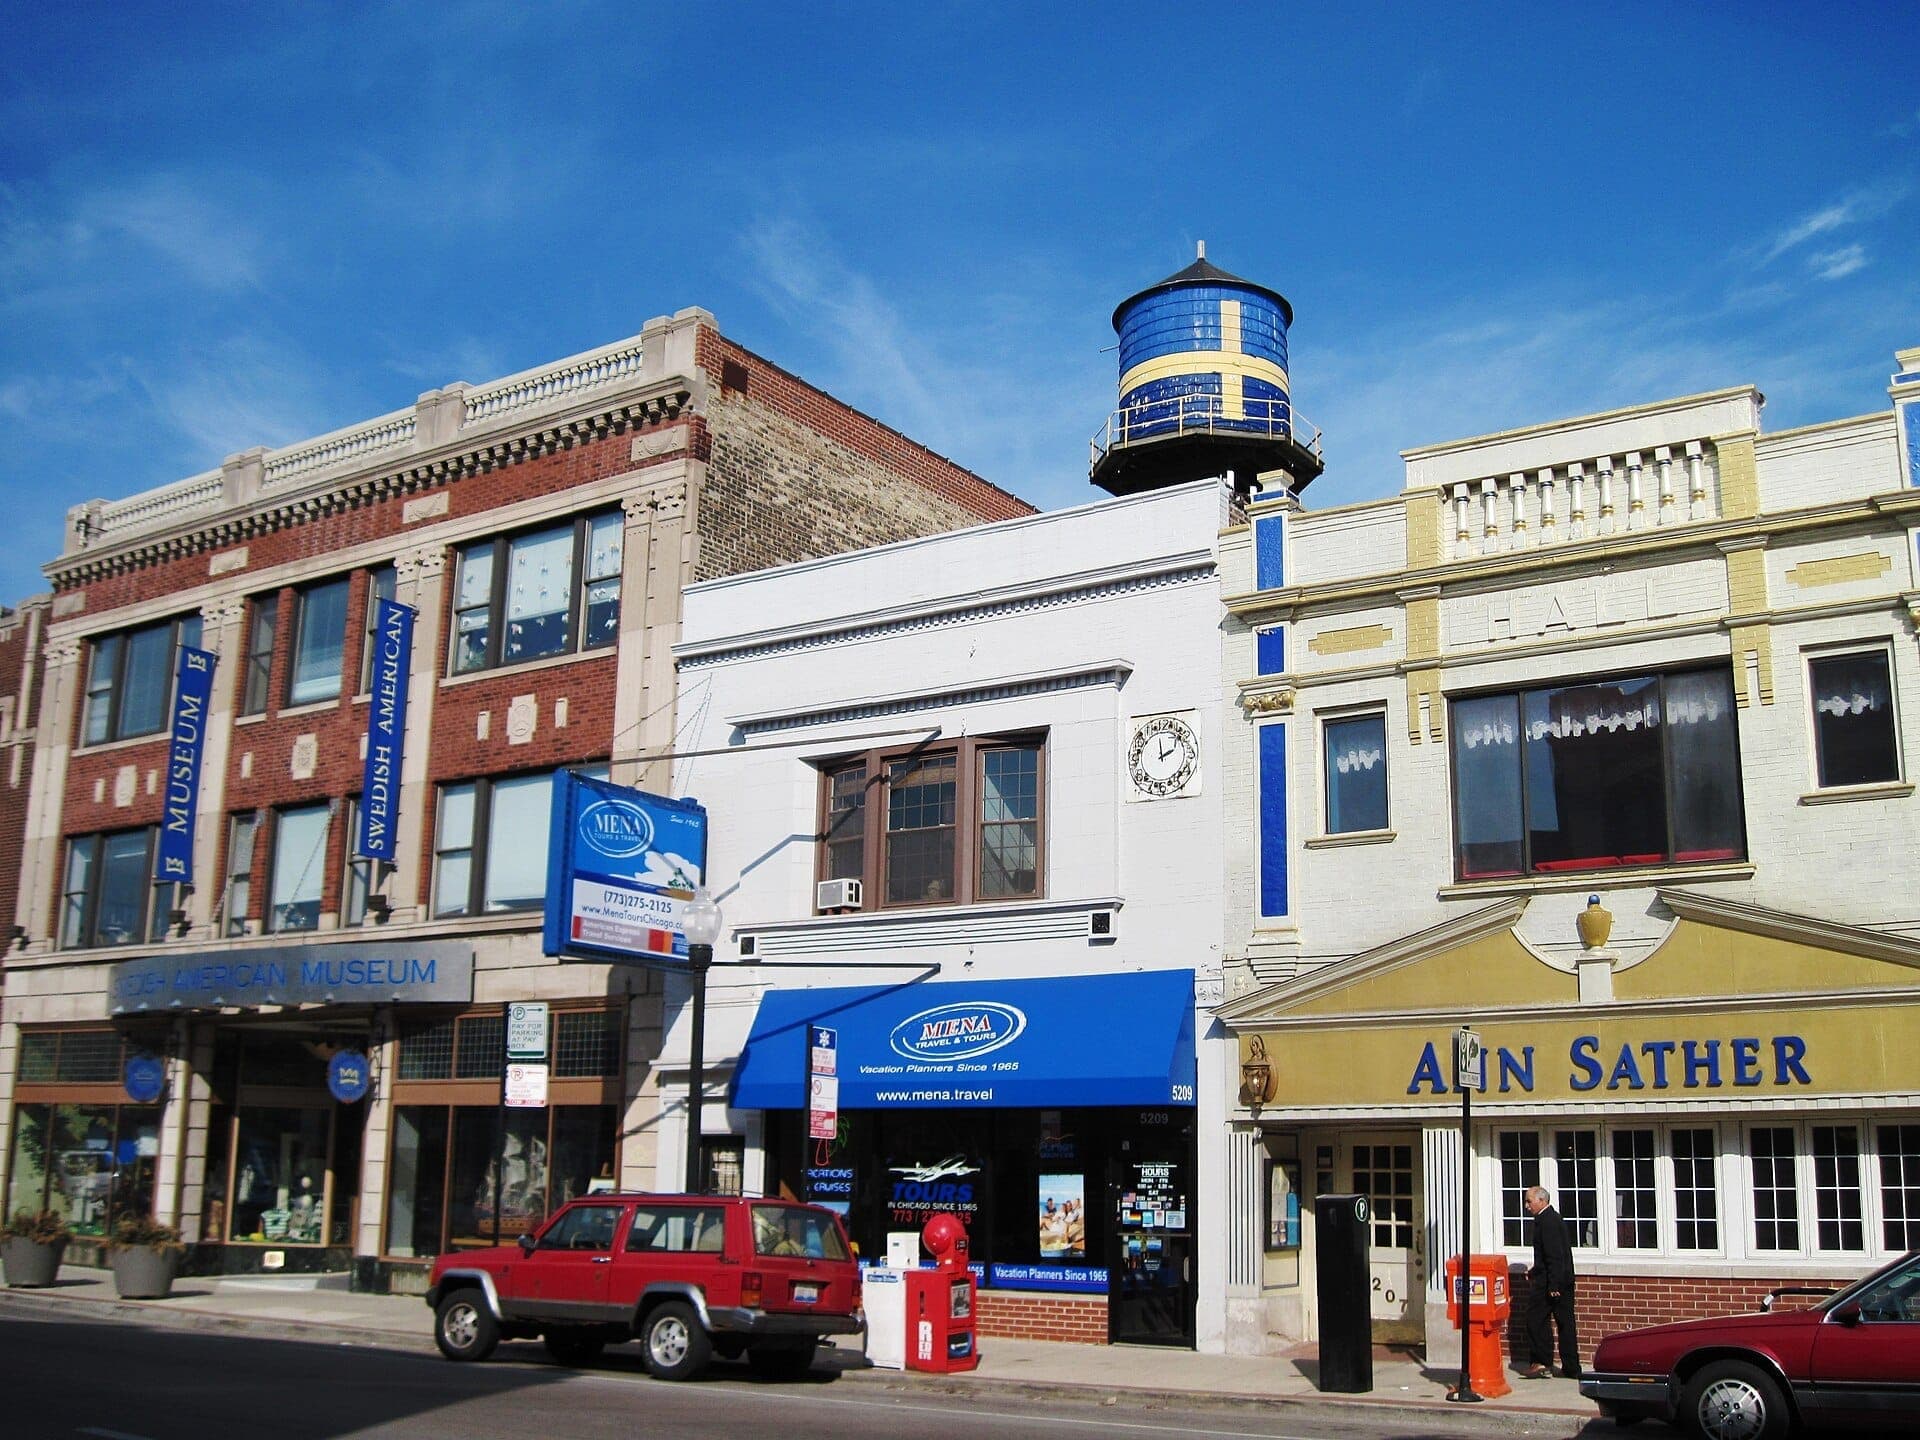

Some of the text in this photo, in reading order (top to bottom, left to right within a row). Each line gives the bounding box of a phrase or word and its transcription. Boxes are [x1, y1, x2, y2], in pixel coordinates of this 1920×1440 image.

[1487, 578, 1679, 642] HALL
[368, 607, 404, 851] SWEDISH AMERICAN
[168, 693, 202, 834] MUSEUM
[595, 813, 642, 834] MENA
[603, 890, 673, 914] (773)275-2125
[173, 962, 287, 991] AMERICAN
[301, 959, 437, 986] MUSEUM
[919, 1014, 992, 1041] MENA
[915, 1039, 951, 1049] TRAVEL
[964, 1032, 997, 1044] TOURS
[860, 1062, 1019, 1074] Vacation Planners Since 1965
[1569, 1035, 1812, 1091] SATHER
[876, 1089, 993, 1101] www.mena.travel
[1172, 1085, 1193, 1101] 5209
[1140, 1112, 1169, 1125] 5209
[807, 1169, 853, 1178] ACATIONS
[1141, 1168, 1170, 1177] HOURS
[814, 1182, 851, 1192] CRUISES
[893, 1182, 975, 1201] TOURS
[897, 1201, 931, 1210] CHICAGO
[932, 1202, 955, 1211] SINCE
[957, 1203, 978, 1211] 1965
[893, 1210, 912, 1222] 773
[995, 1267, 1108, 1282] Vacation Planners Since 1965
